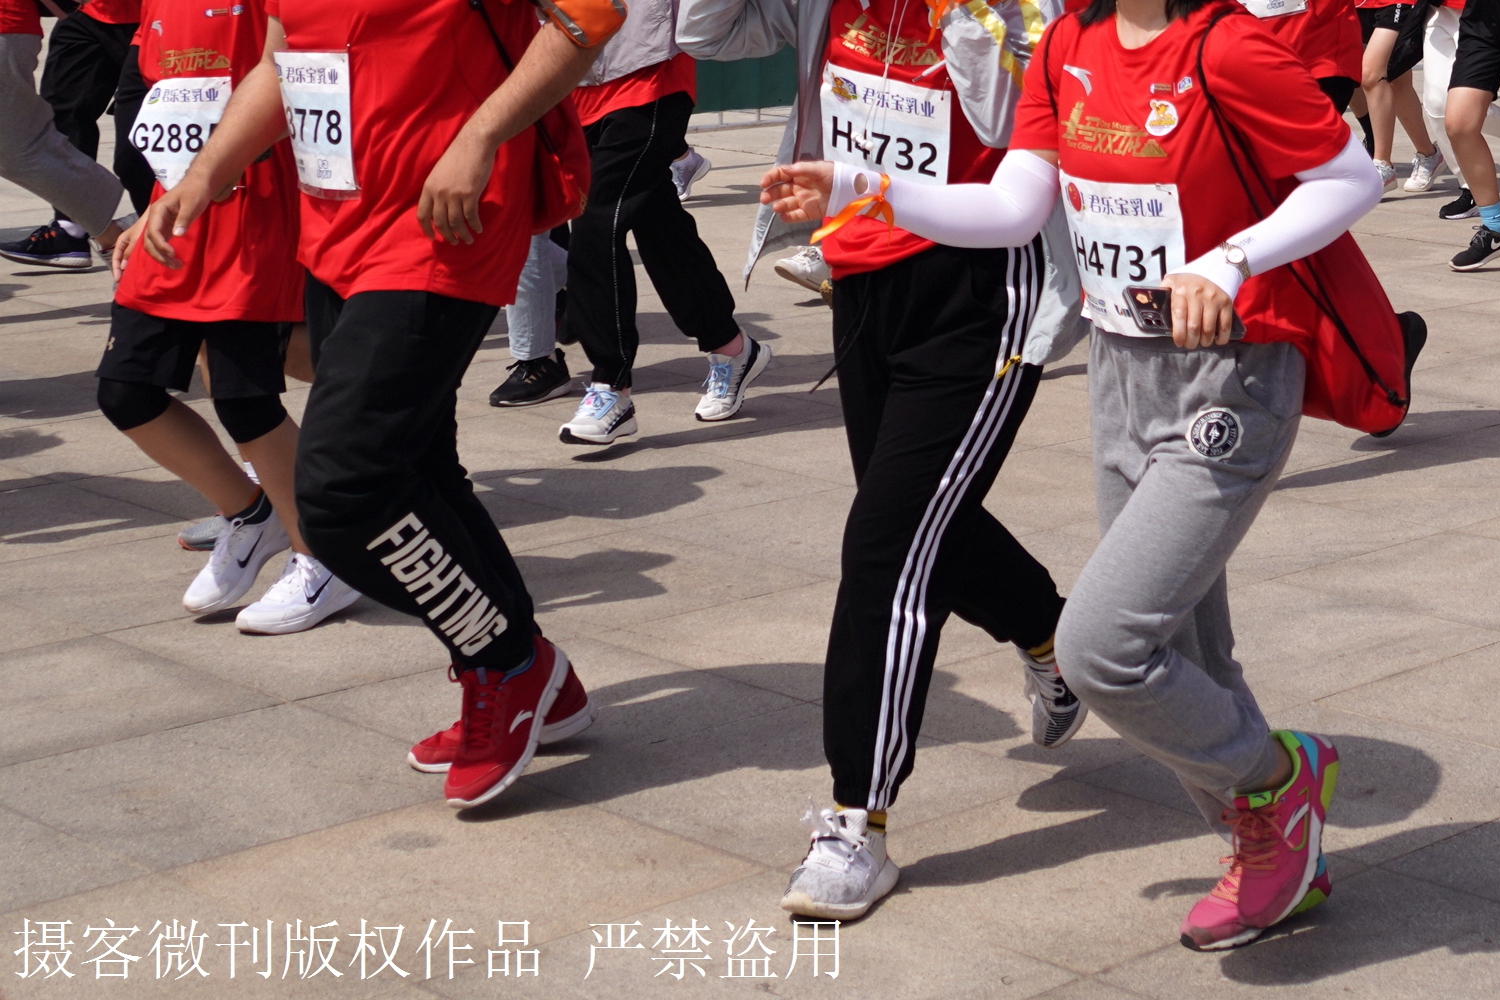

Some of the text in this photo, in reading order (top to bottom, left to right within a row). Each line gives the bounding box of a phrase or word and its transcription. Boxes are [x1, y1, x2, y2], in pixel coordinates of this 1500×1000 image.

[286, 66, 339, 85] 君乐宝乳业
[162, 87, 220, 104] 君乐宝乳业
[862, 86, 936, 119] 君乐宝乳业
[285, 105, 343, 145] 3778
[831, 115, 938, 178] H4732
[1077, 141, 1093, 152] Cities
[1088, 193, 1165, 218] 君乐宝乳业
[1073, 230, 1168, 283] H4731
[365, 511, 508, 657] FIGHTING
